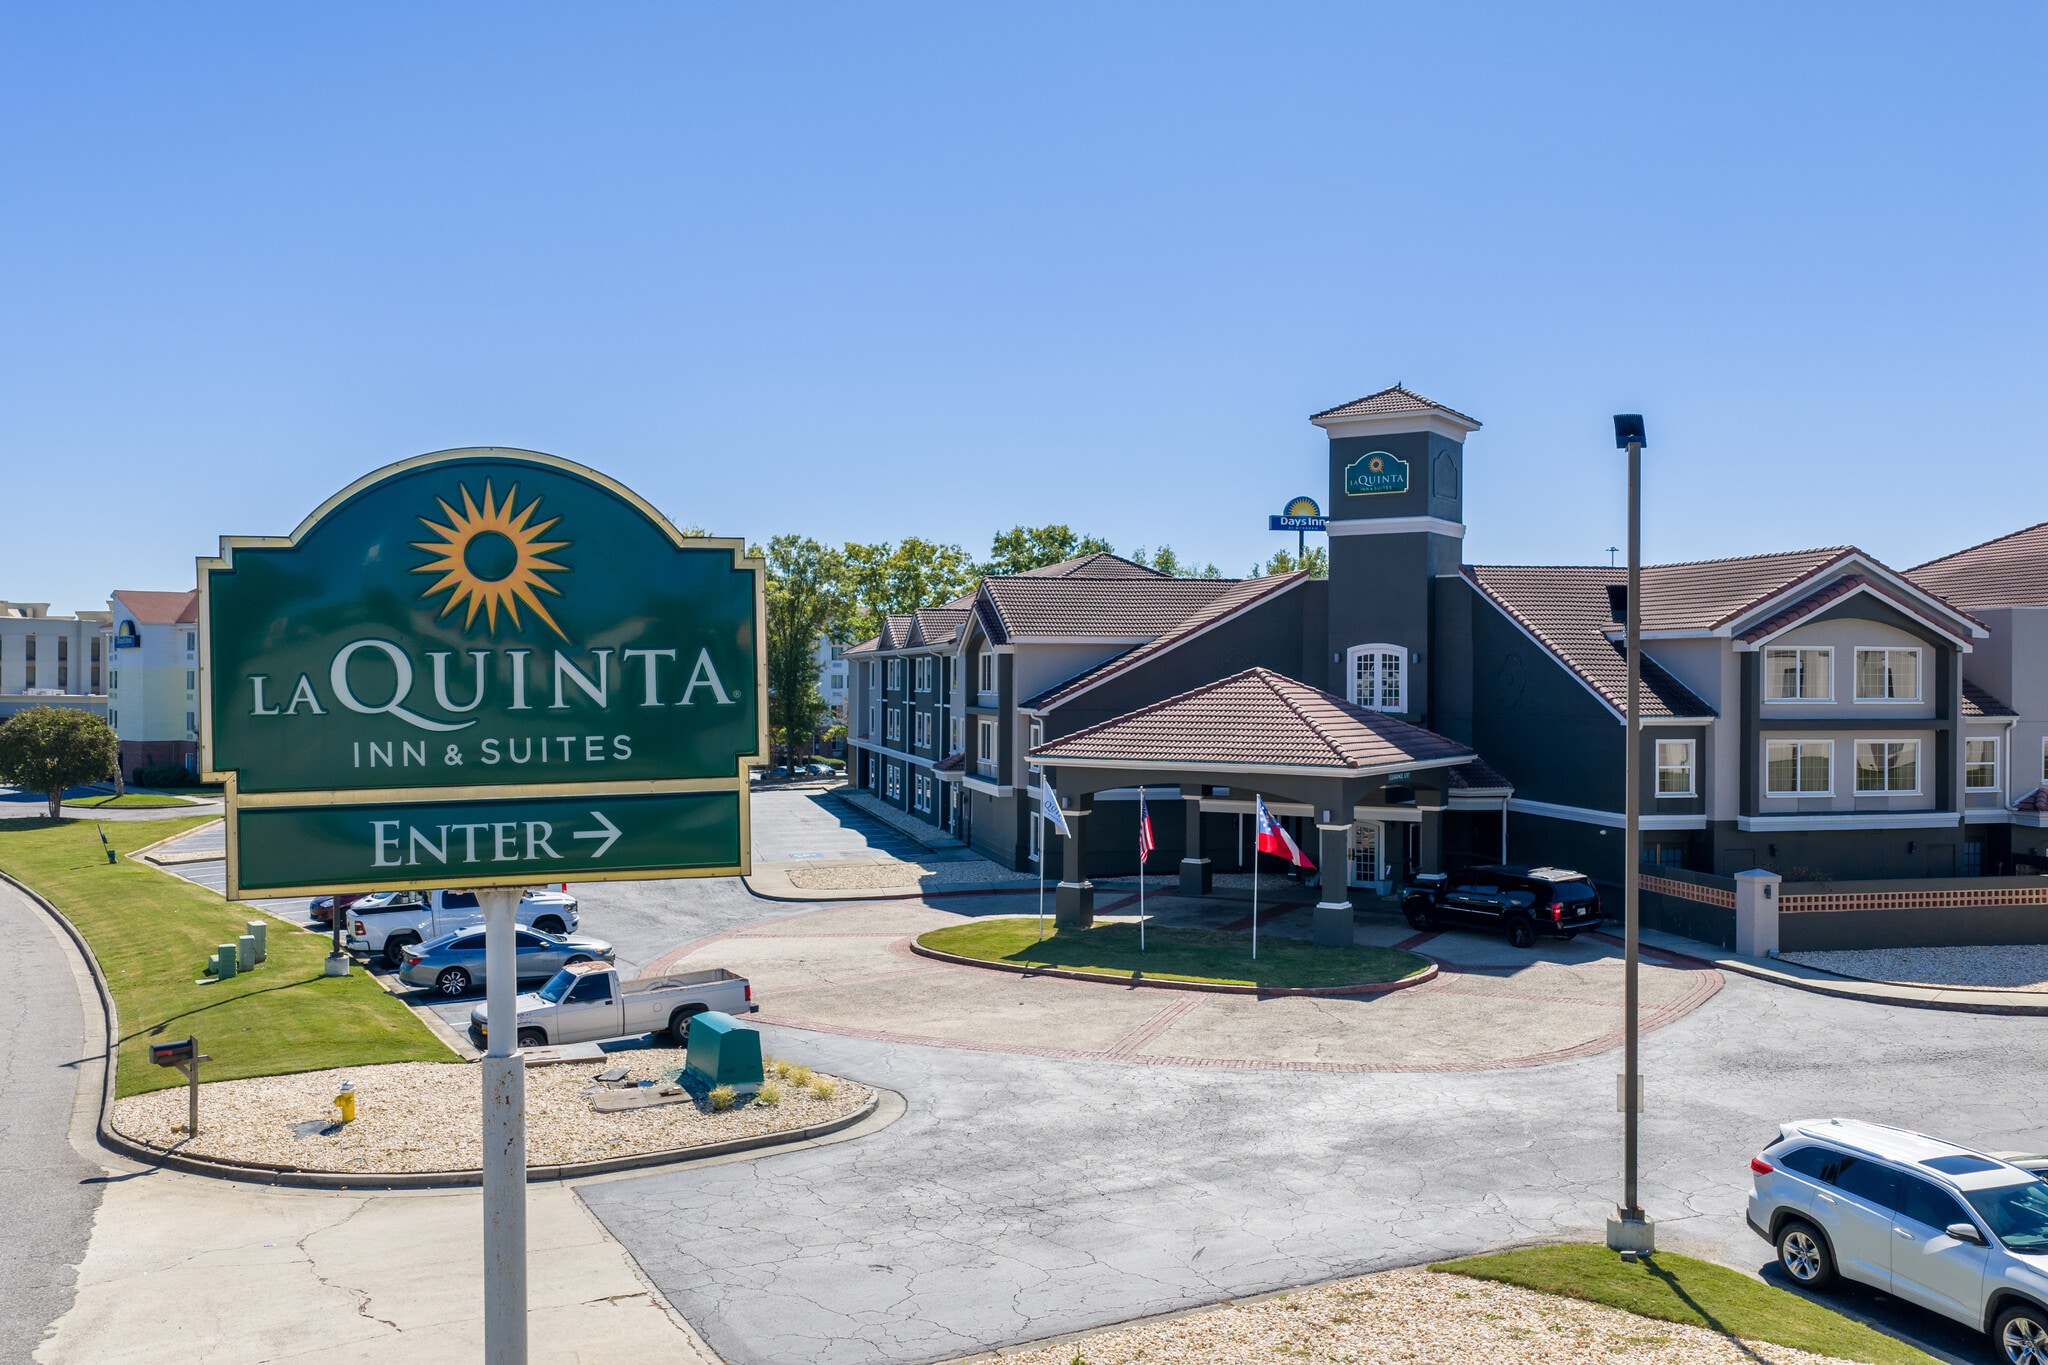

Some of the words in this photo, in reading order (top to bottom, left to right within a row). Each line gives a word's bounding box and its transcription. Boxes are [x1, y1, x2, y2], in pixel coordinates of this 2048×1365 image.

[1358, 474, 1404, 487] QUINTA
[1280, 516, 1307, 527] Days
[1308, 517, 1326, 526] Inn
[250, 673, 328, 716] LA
[330, 639, 737, 732] QUINTA
[353, 741, 426, 768] INN
[444, 744, 464, 766] &
[481, 735, 632, 765] SUITES
[369, 820, 564, 868] ENTER
